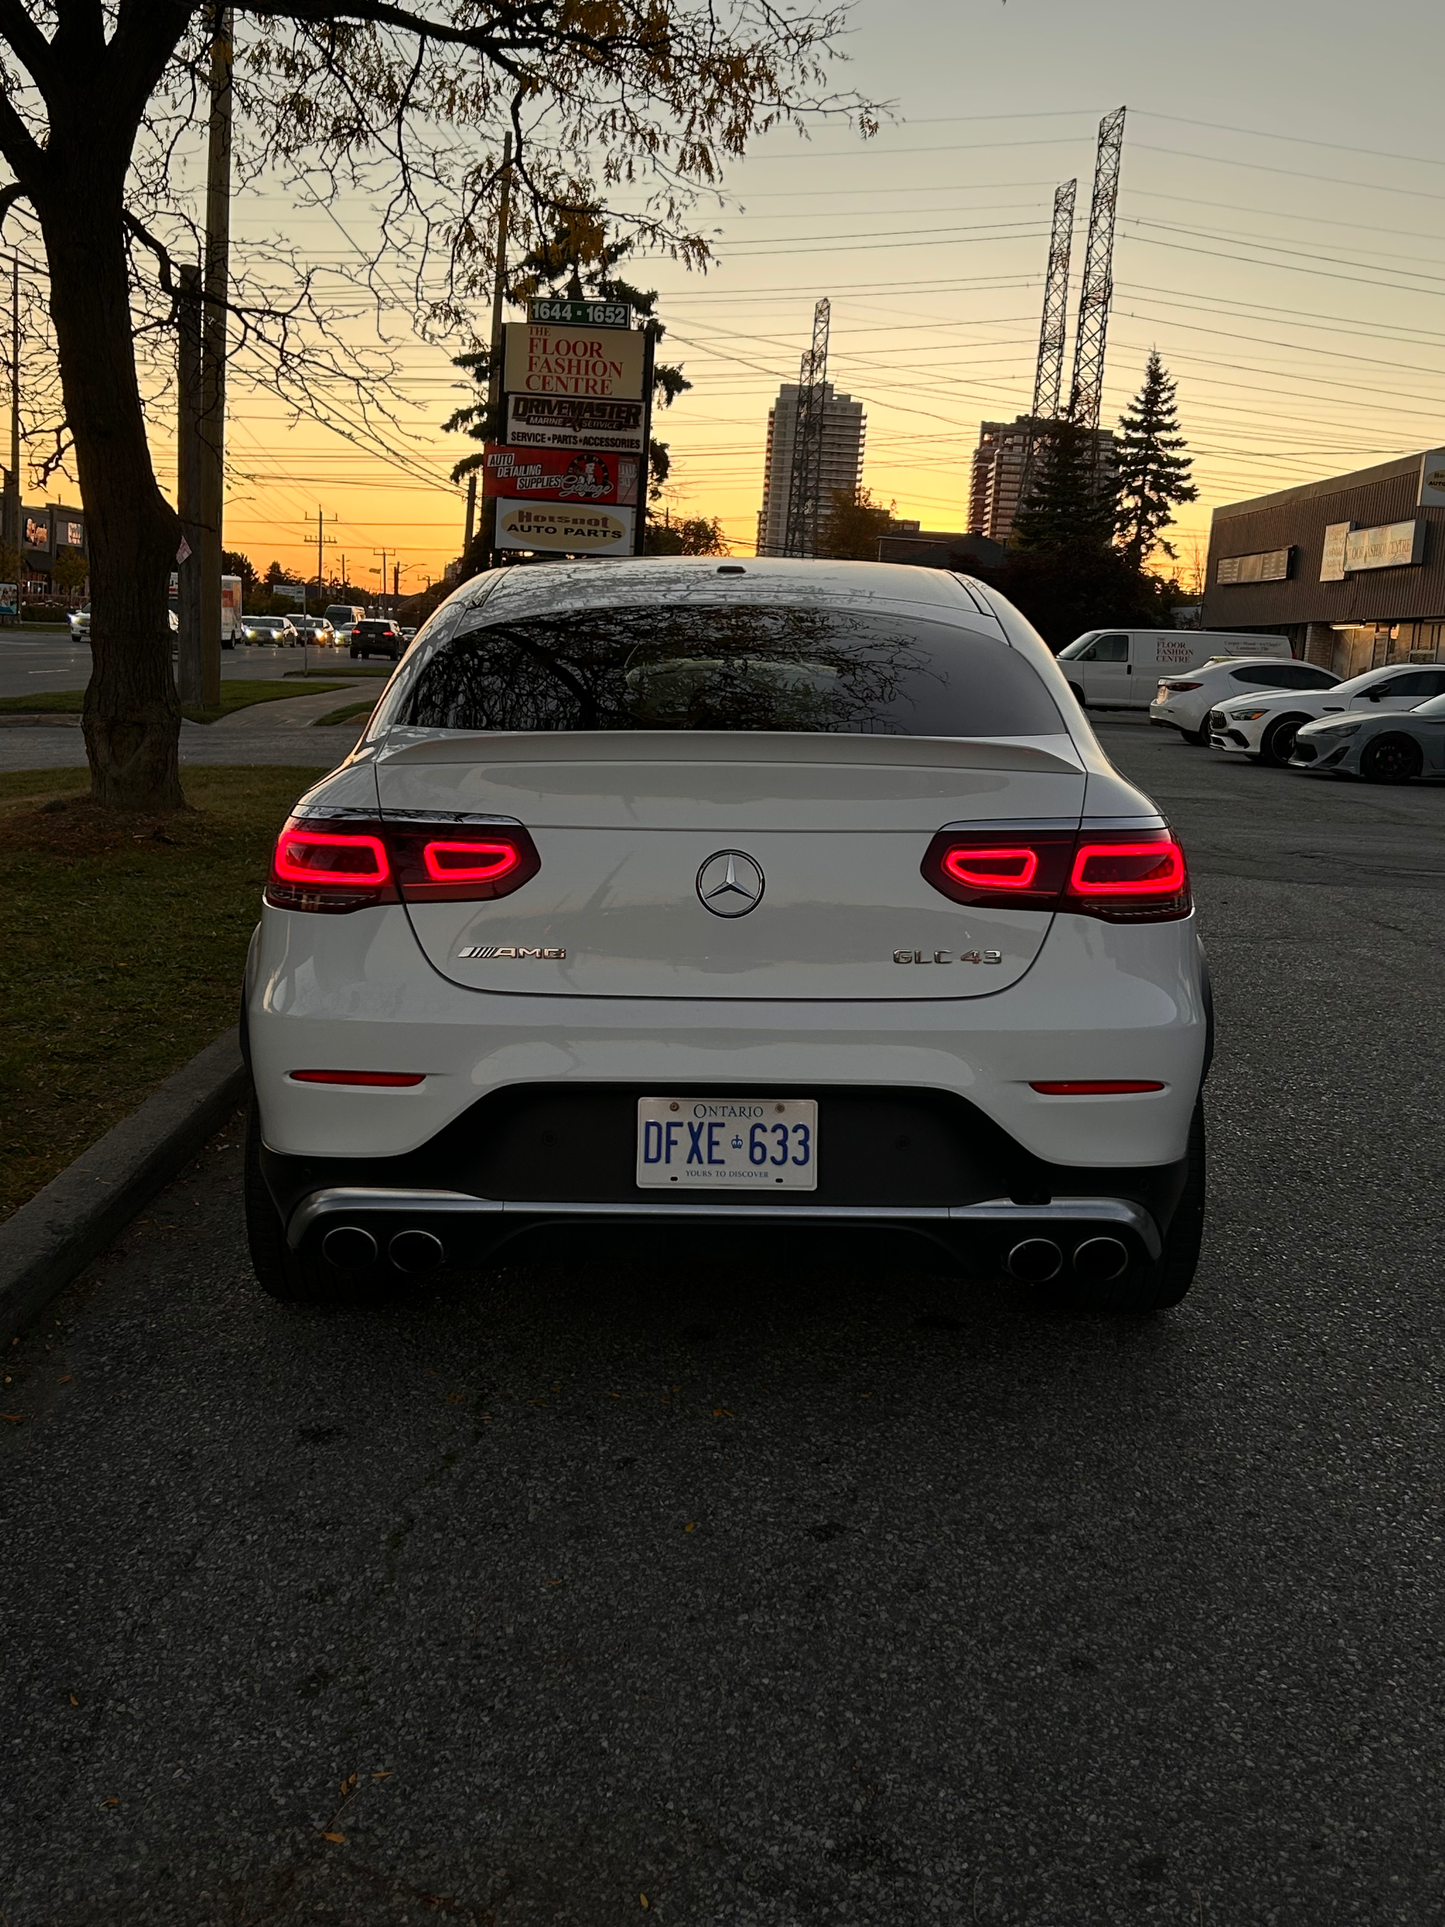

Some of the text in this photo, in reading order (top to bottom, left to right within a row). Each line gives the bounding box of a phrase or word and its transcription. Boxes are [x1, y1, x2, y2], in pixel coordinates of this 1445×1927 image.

[532, 302, 626, 324] 1644 1652
[528, 326, 551, 337] THE
[527, 337, 604, 359] FLOOR
[527, 355, 624, 378] FASHION
[525, 374, 613, 396] CENTRE
[512, 398, 642, 425] DRIVEMASTER
[529, 416, 620, 430] MARINE SERVICE
[511, 431, 641, 449] SERVICE PARTS ACCESSORIES
[489, 453, 514, 466] AUTO
[496, 464, 542, 478] DETAILING
[518, 476, 560, 490] SUPPLIES
[558, 474, 615, 498] Garage
[507, 523, 622, 539] AUTO PARTS
[1156, 655, 1190, 663] CENTRE
[1157, 648, 1194, 656] FASHION
[493, 946, 566, 959] AMG
[893, 948, 1002, 964] GLC 43
[693, 1103, 764, 1119] ONTARIO
[643, 1120, 810, 1166] DFXE 633
[729, 1171, 769, 1179] DISCOVER
